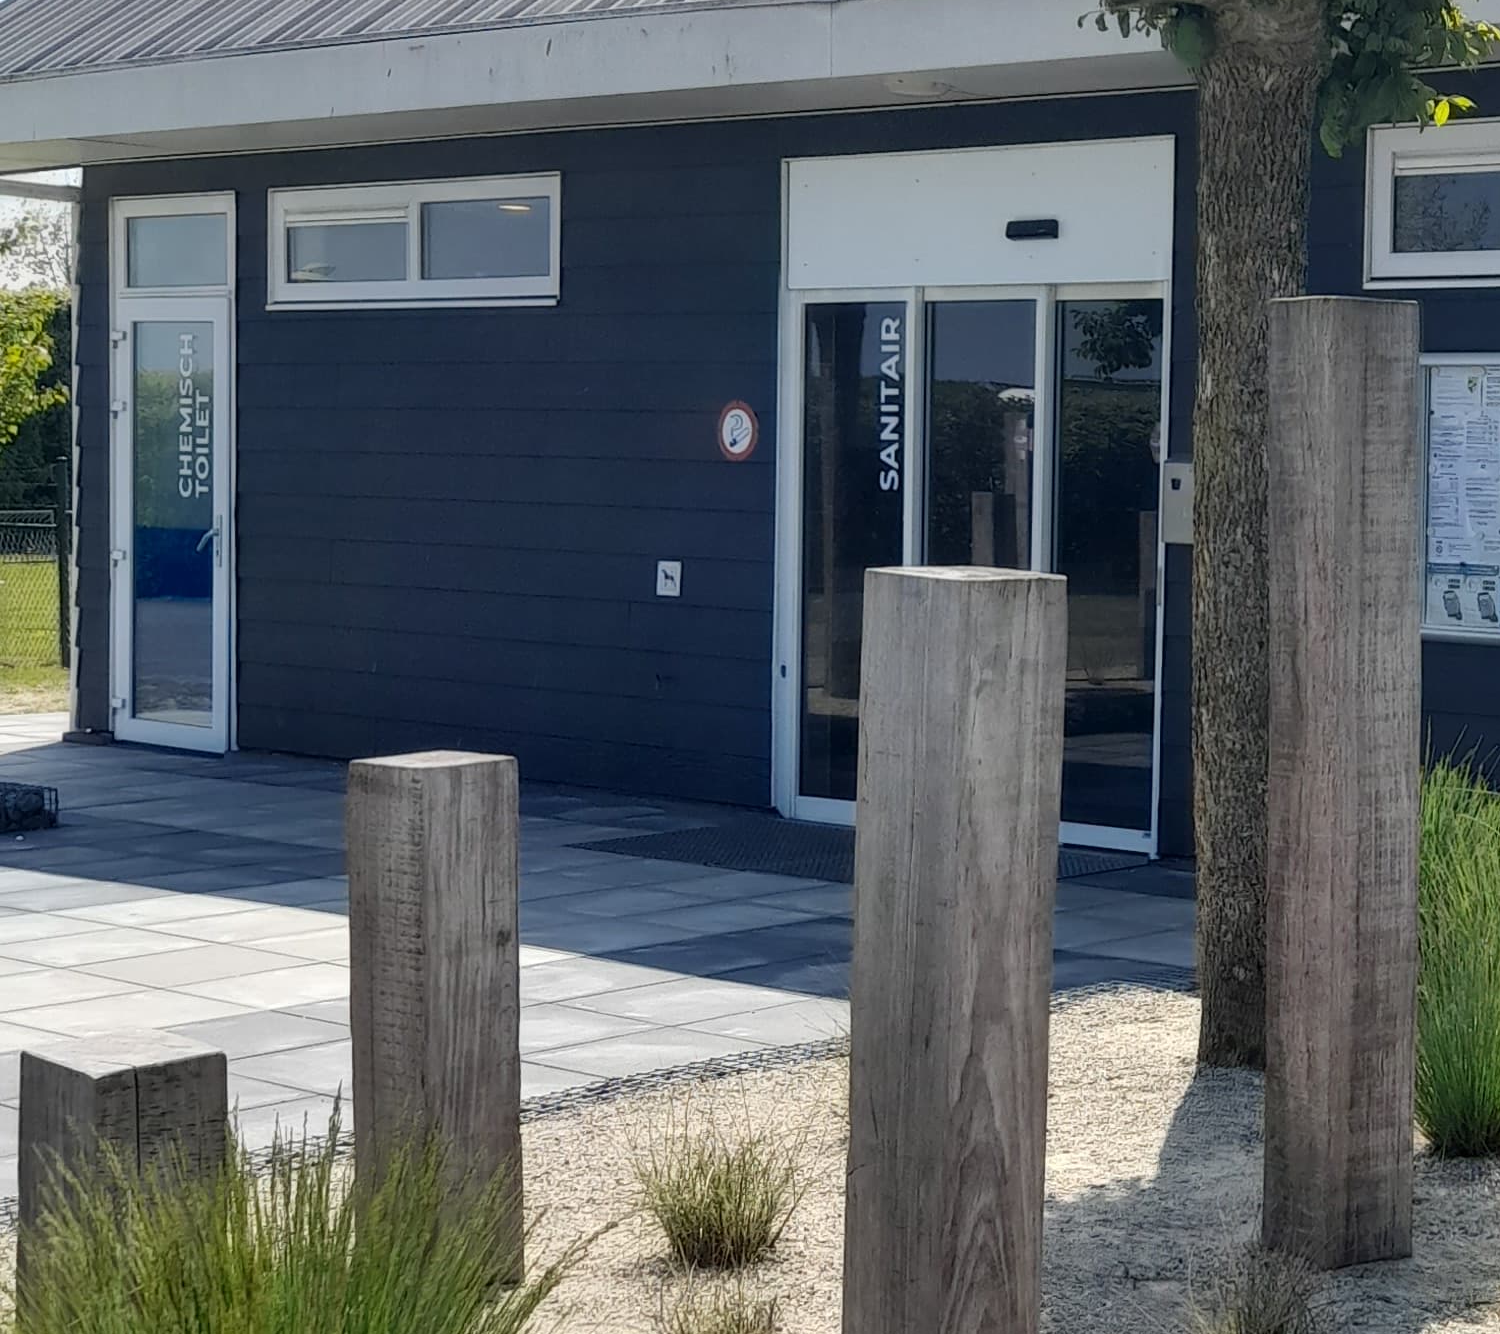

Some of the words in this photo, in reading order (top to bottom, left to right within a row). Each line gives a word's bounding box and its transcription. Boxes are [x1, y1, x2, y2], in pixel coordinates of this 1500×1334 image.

[178, 333, 193, 498] CHEMISCH
[195, 389, 210, 498] TOILET
[879, 317, 900, 491] SANITAIR
